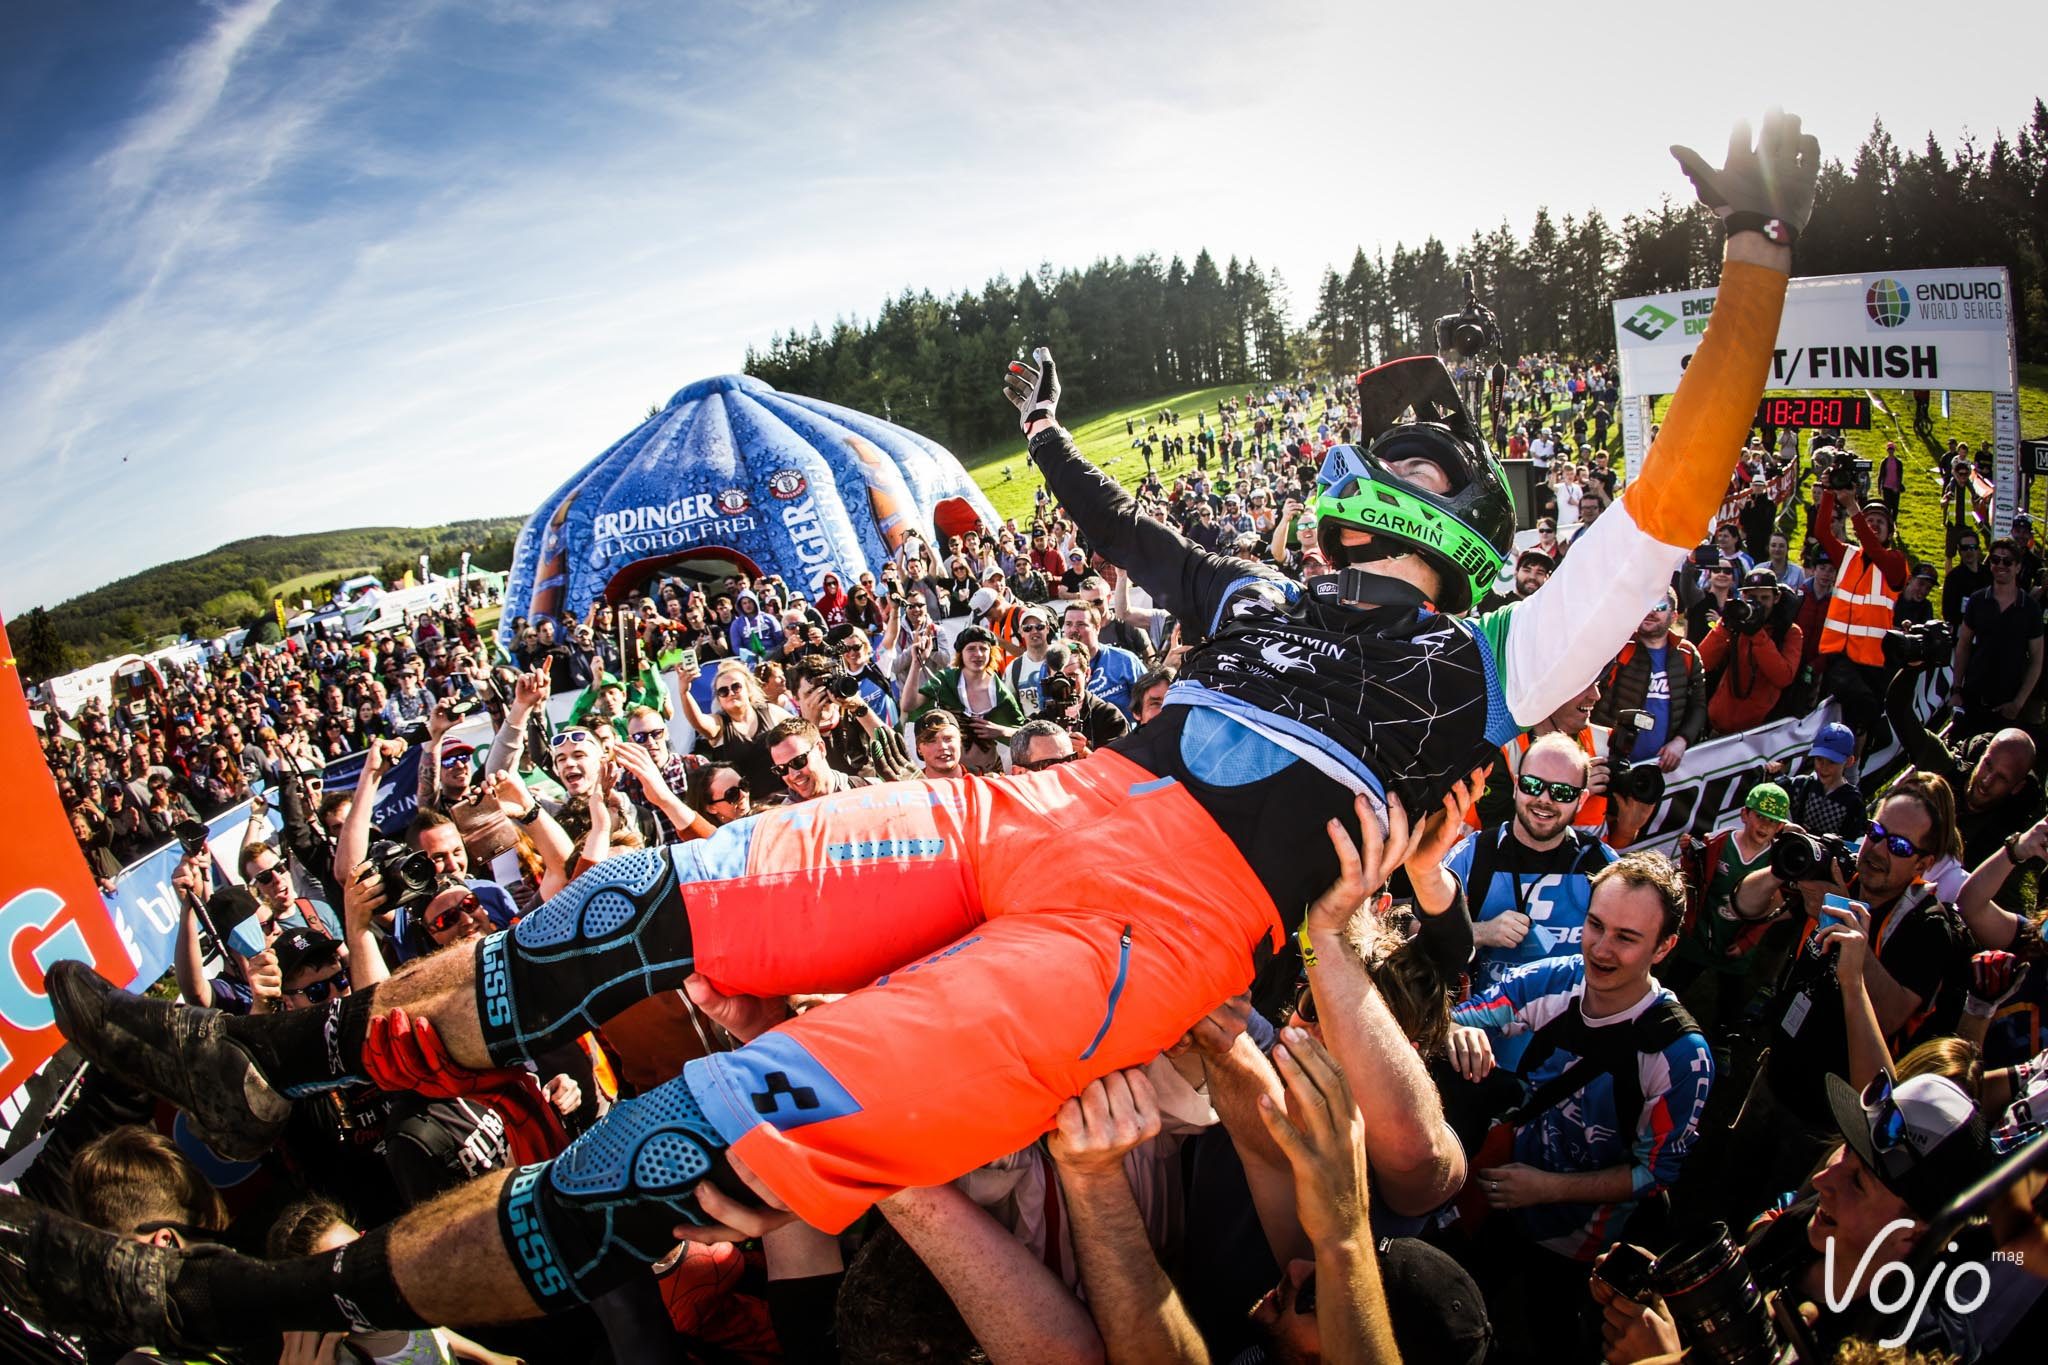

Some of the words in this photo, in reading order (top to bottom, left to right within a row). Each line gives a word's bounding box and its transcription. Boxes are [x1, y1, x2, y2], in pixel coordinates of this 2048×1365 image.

[1919, 303, 1958, 320] WORLD
[1964, 302, 2002, 319] SERIES
[594, 493, 719, 541] ERDINGER
[1361, 508, 1443, 547] GARMIN
